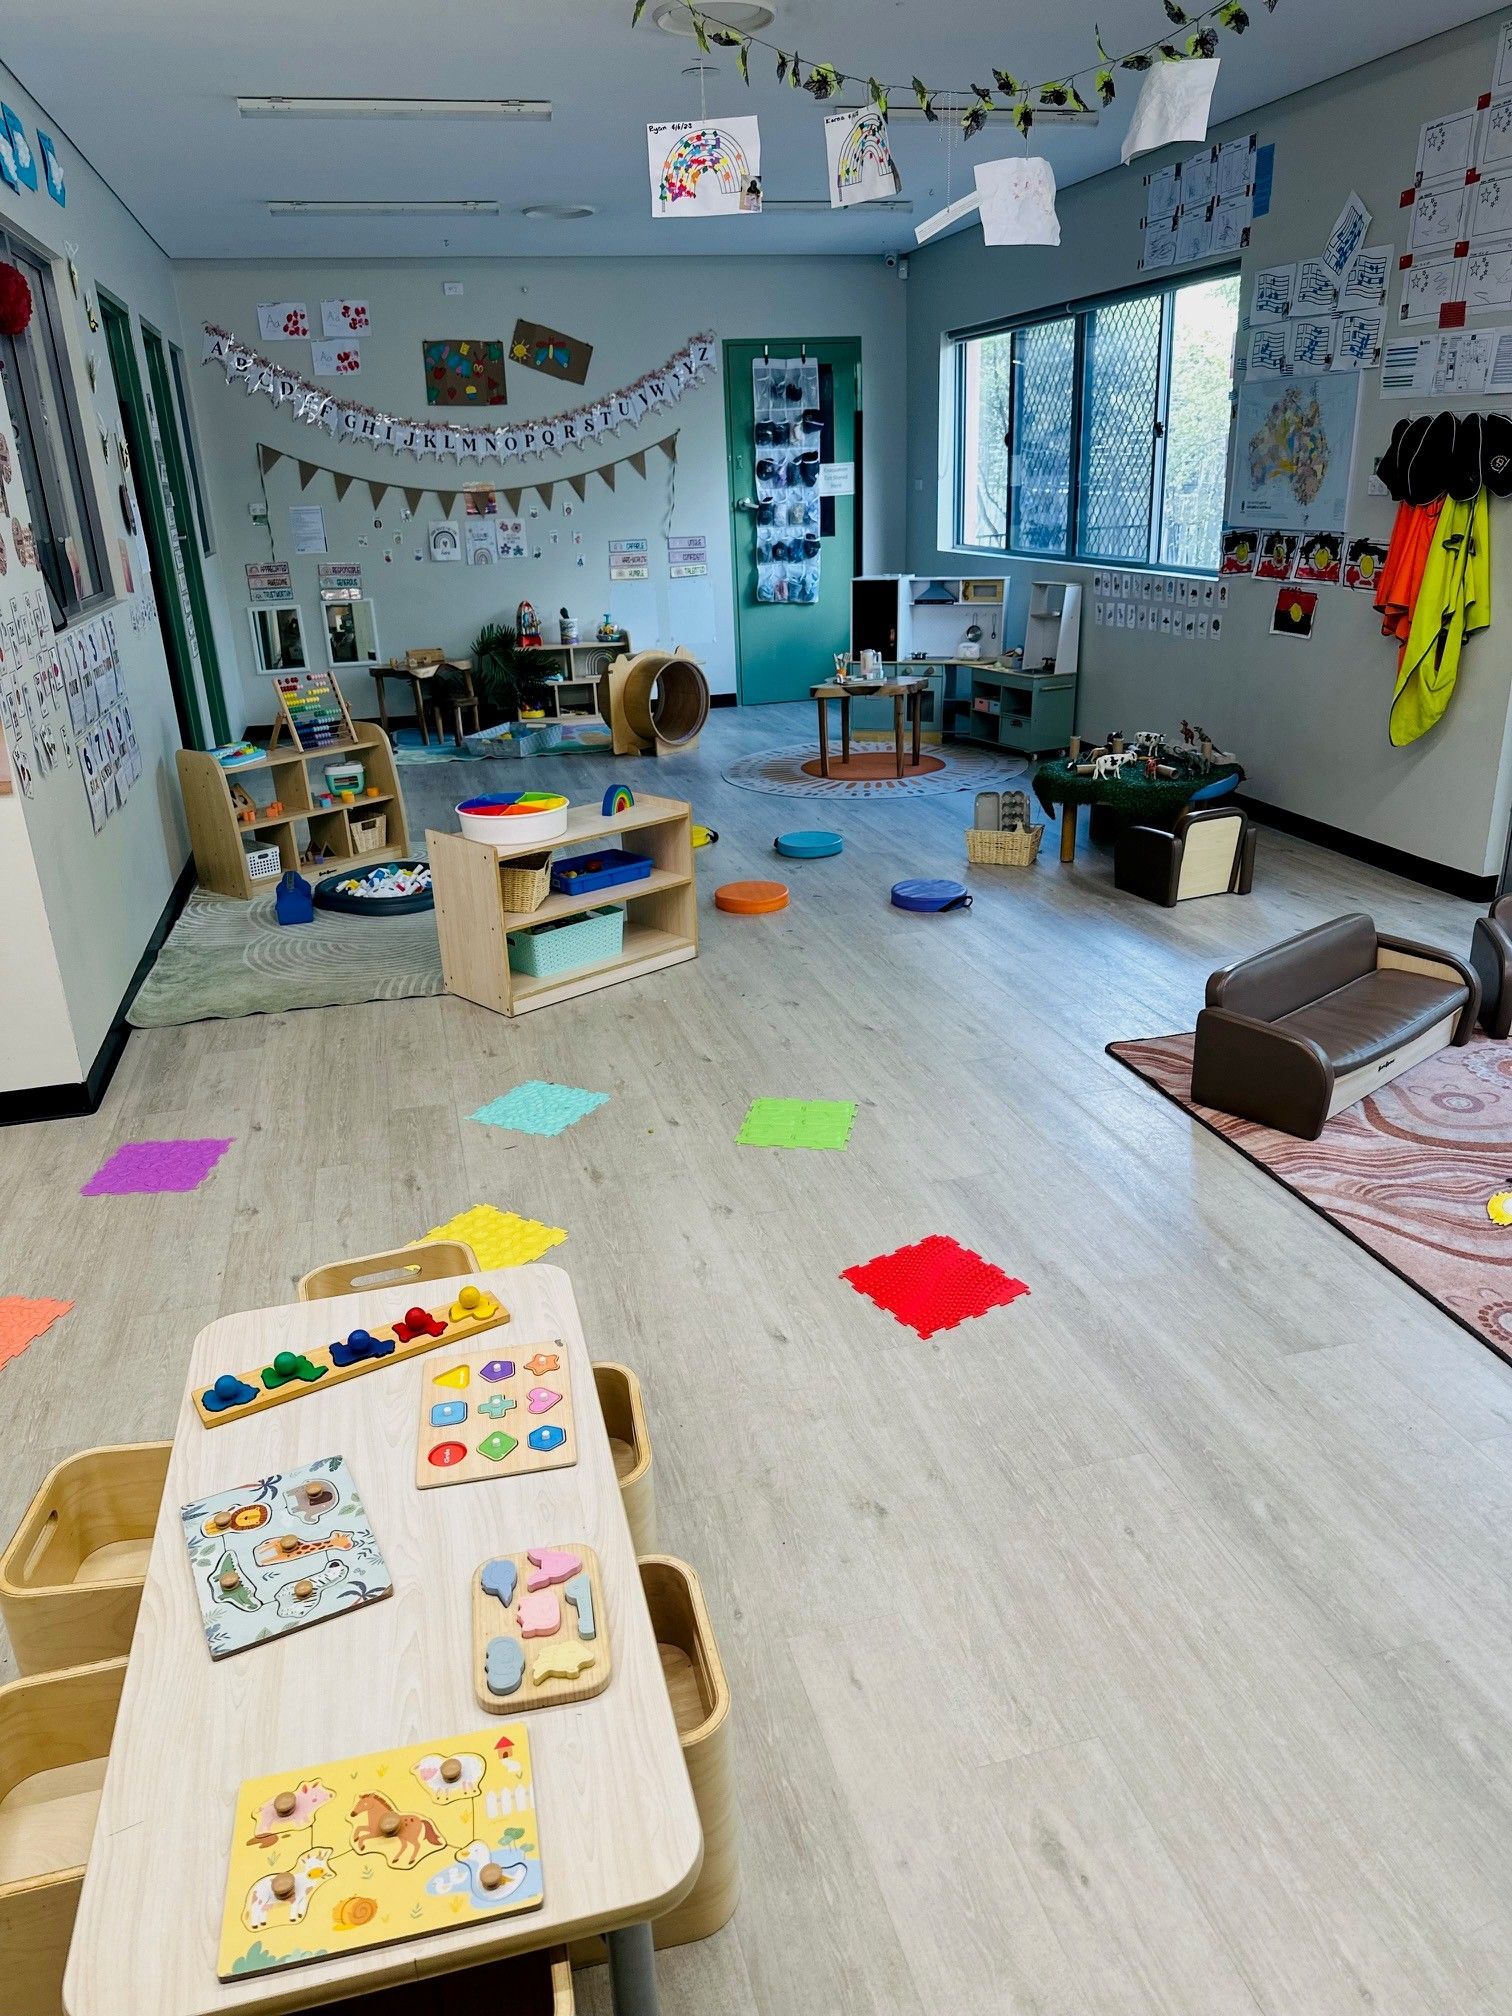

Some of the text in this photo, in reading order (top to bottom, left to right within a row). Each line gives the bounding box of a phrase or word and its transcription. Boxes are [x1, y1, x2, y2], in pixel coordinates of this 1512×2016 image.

[649, 125, 667, 135] Ryan
[84, 747, 93, 776] 6
[95, 733, 103, 762] 7
